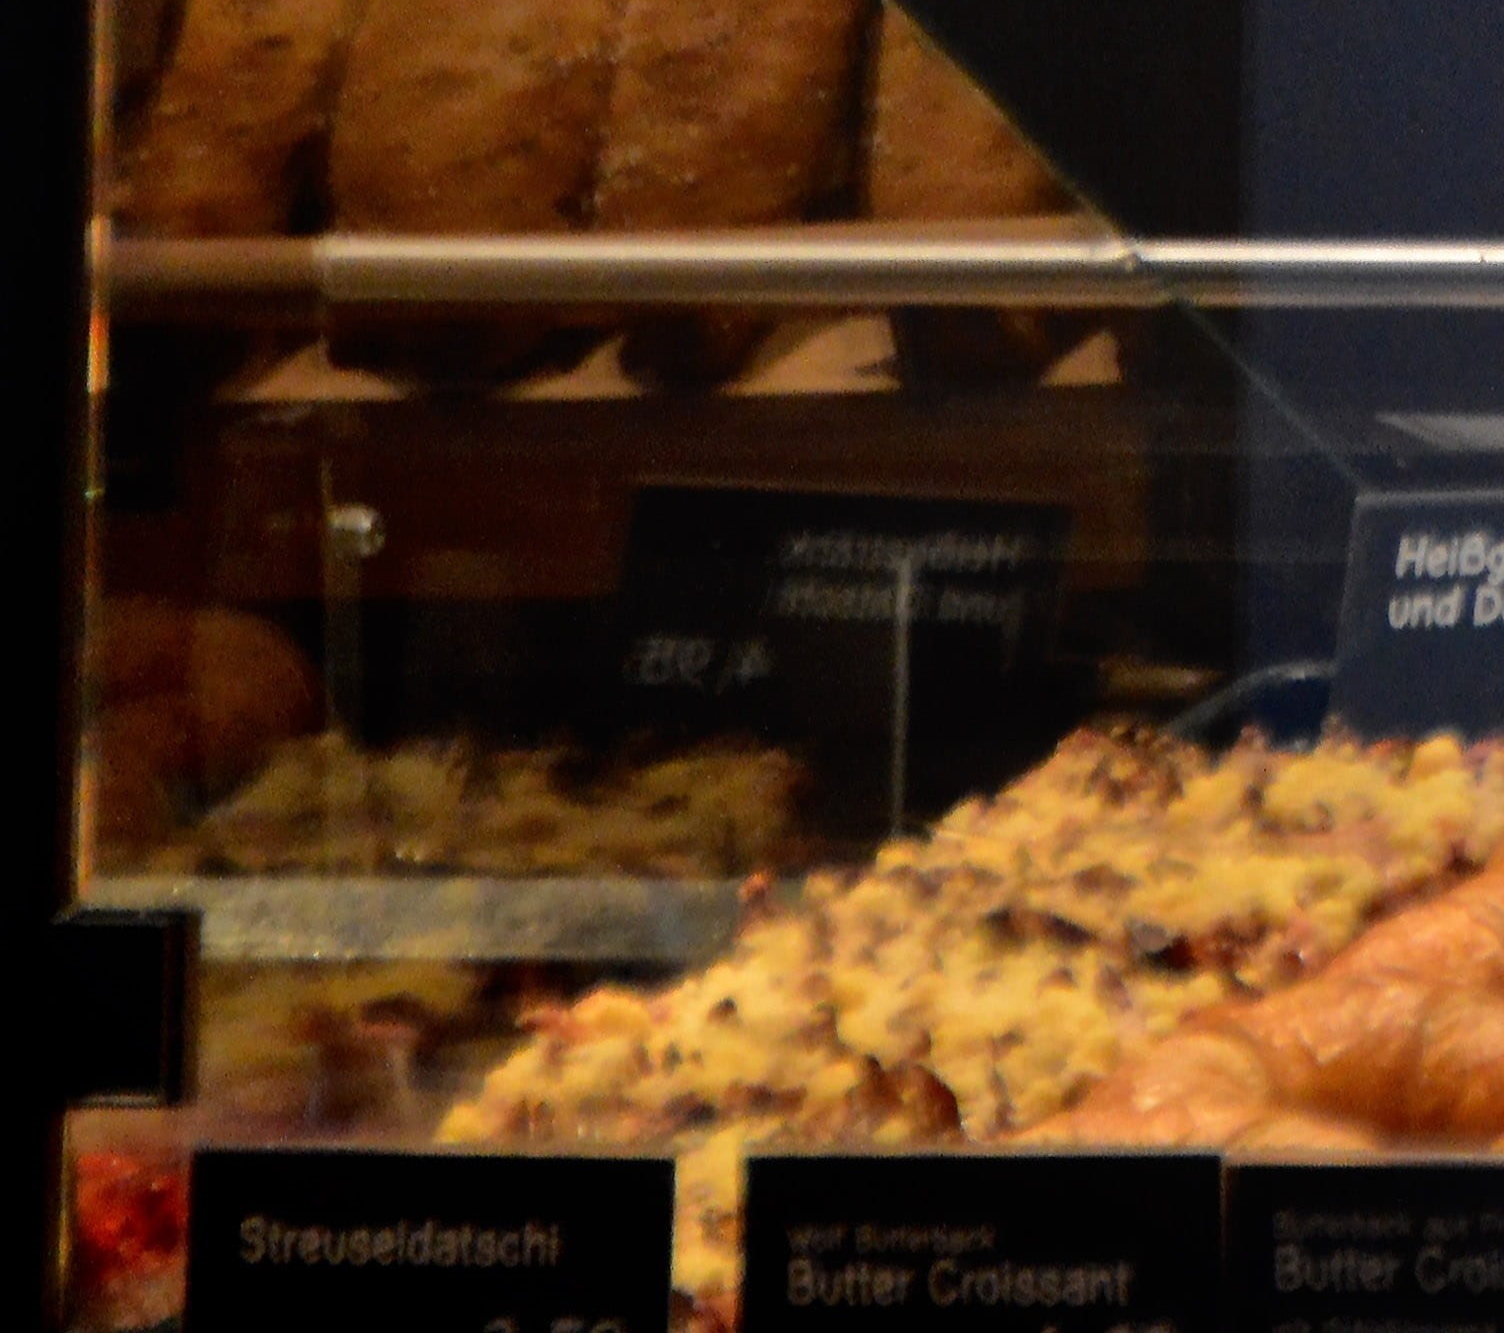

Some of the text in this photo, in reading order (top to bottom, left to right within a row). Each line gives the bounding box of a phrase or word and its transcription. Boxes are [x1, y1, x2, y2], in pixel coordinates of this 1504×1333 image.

[1388, 585, 1462, 630] und
[239, 1215, 562, 1266] Streuseldatschi
[787, 1257, 1136, 1309] Butter Croissant
[1273, 1242, 1402, 1295] Butter
